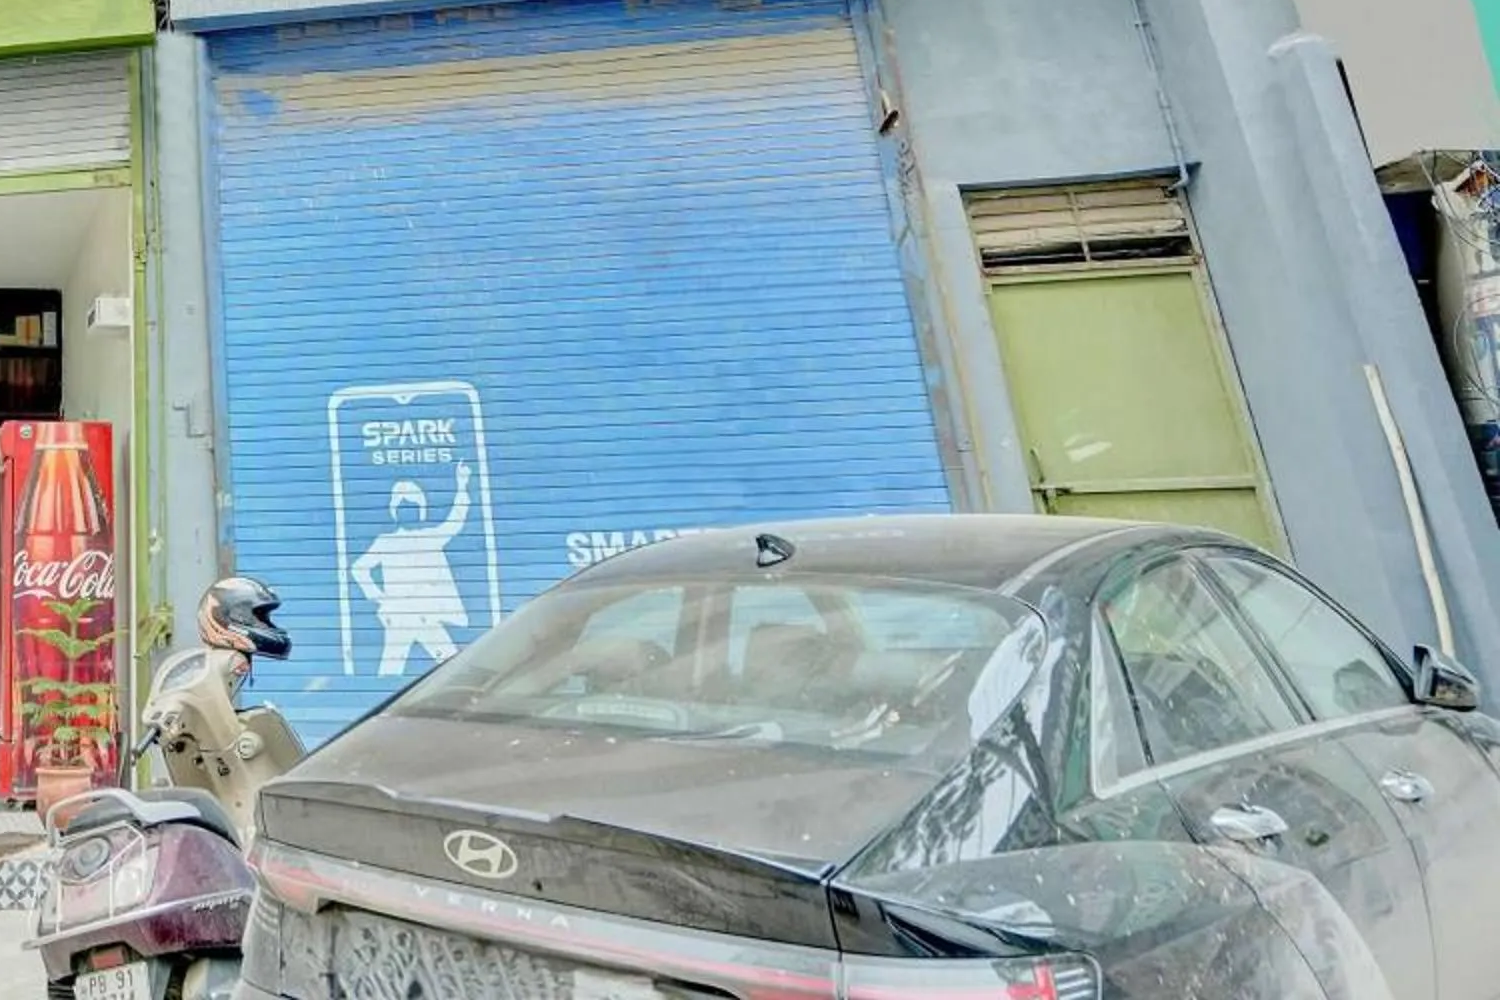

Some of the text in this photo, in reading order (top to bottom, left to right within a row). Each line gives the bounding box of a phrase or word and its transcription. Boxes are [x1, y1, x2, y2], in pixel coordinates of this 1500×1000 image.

[362, 419, 457, 448] SPARK
[372, 448, 453, 465] SERIES
[413, 885, 570, 929] VERNA
[115, 968, 133, 990] 91
